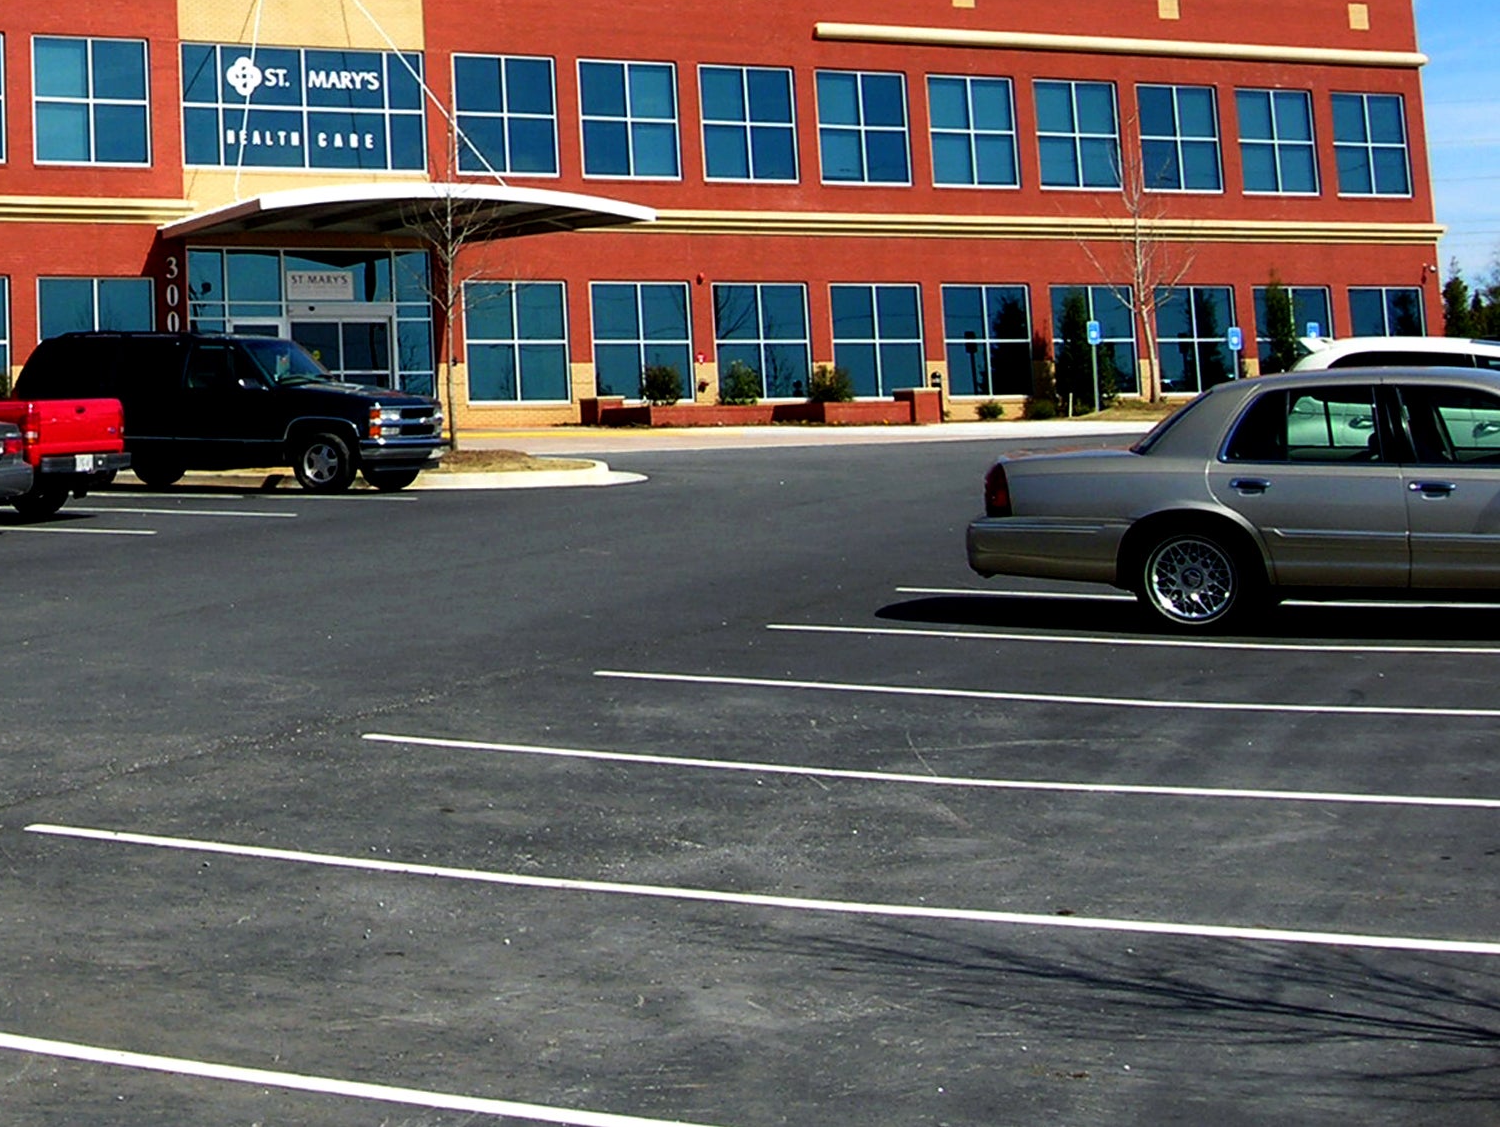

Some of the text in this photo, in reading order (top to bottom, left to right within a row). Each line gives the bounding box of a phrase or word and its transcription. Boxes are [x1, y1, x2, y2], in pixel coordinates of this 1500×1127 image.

[264, 68, 381, 91] ST. MARY'S
[226, 129, 375, 149] HEALTH CARE
[307, 274, 349, 285] MARY'S
